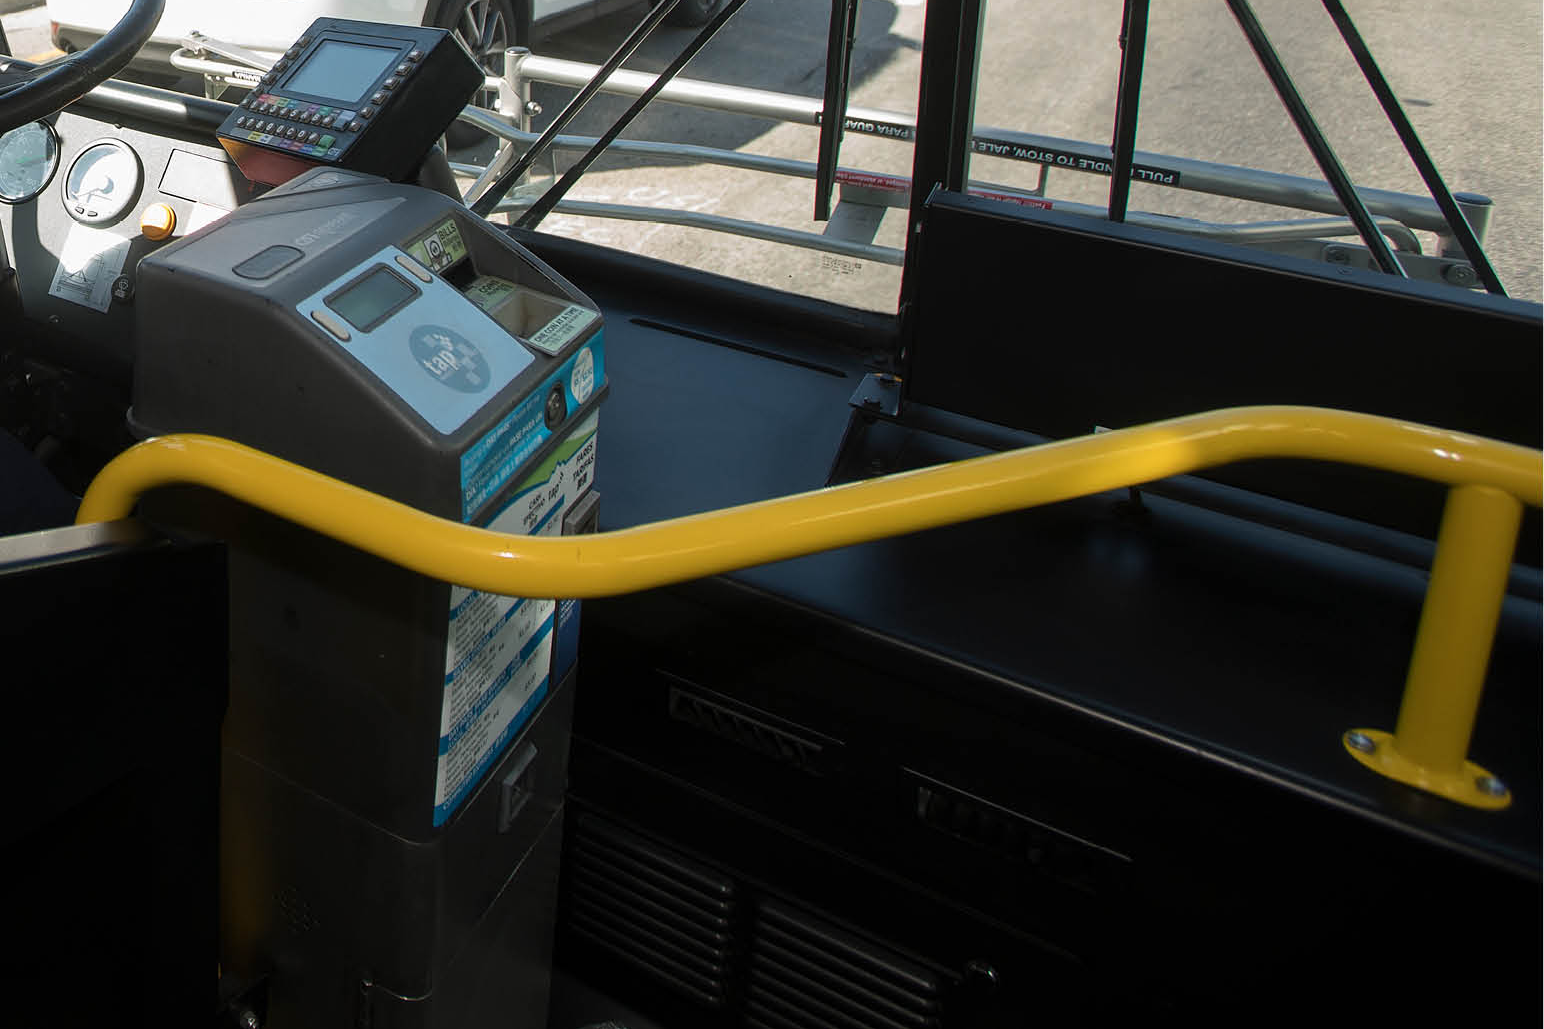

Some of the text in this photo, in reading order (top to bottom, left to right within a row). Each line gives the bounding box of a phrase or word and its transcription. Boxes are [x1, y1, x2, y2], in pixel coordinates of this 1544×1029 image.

[978, 142, 1010, 155] JALE
[1056, 155, 1075, 166] TO
[1136, 170, 1174, 184] PULL
[423, 350, 460, 376] tap
